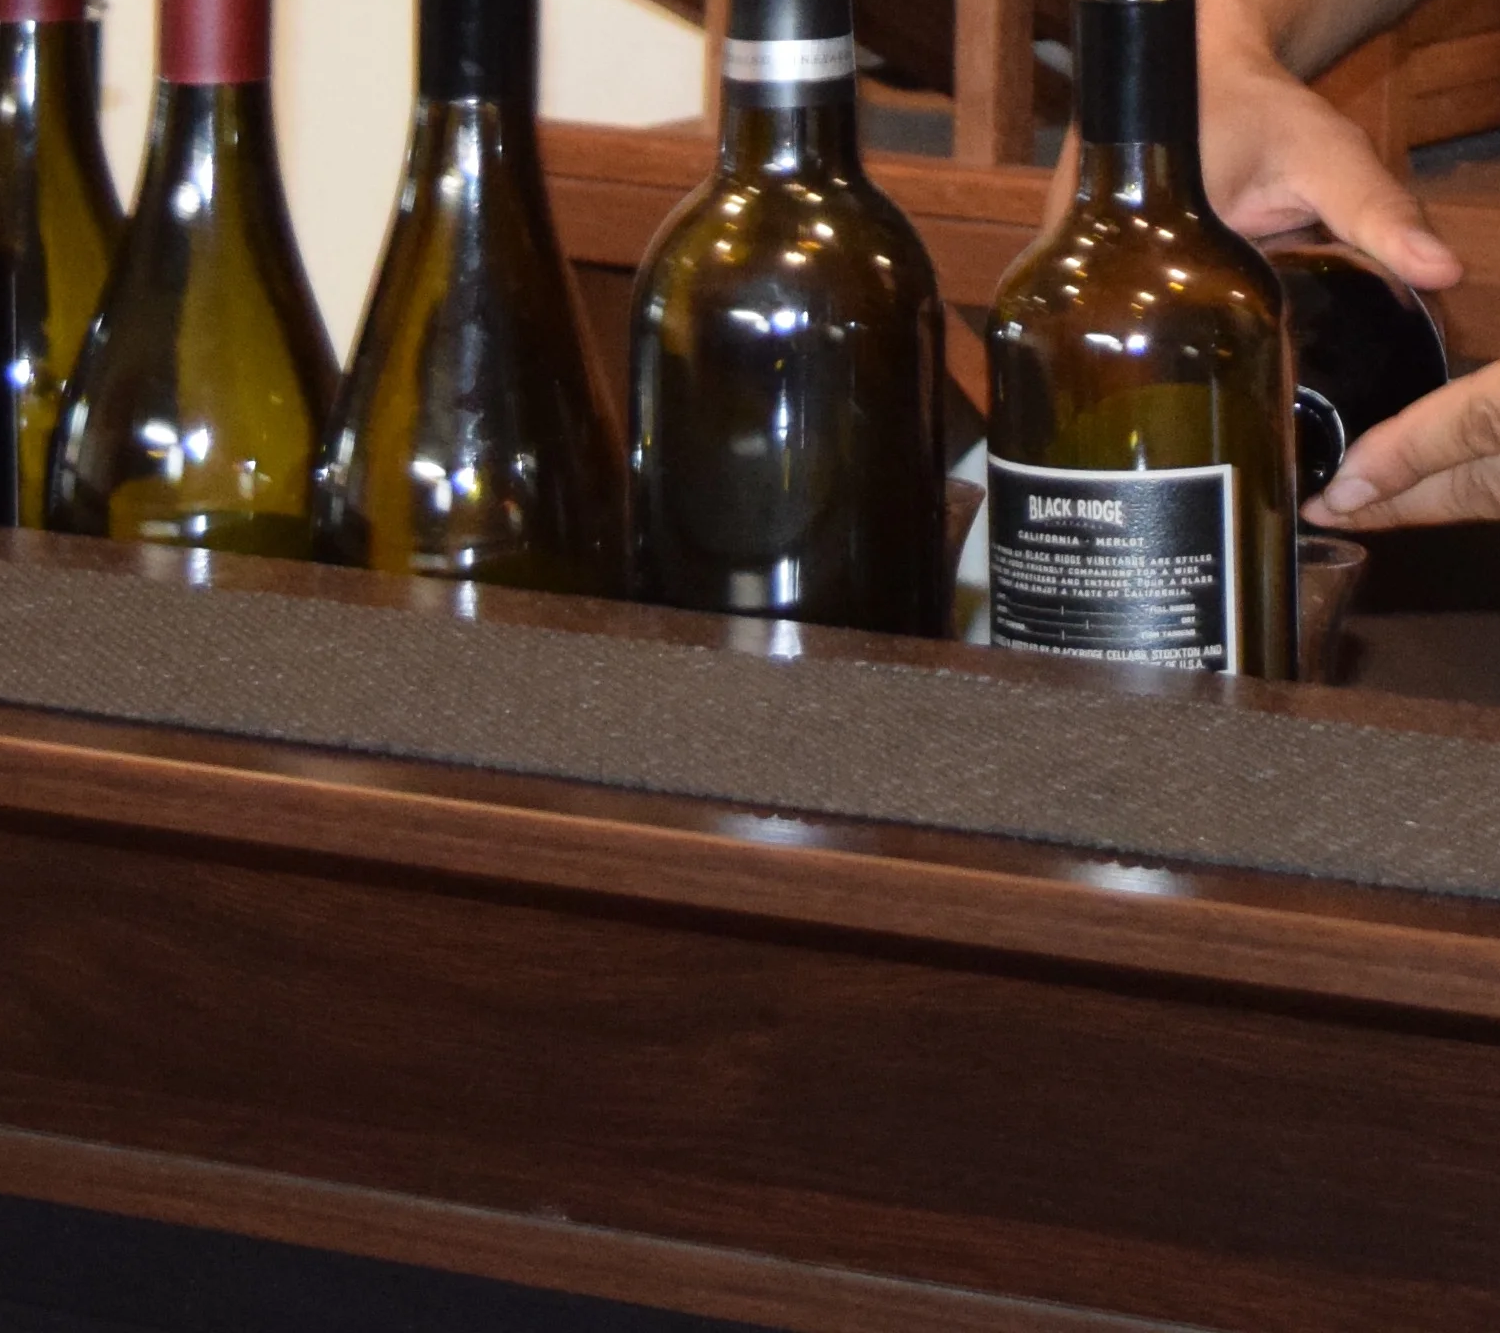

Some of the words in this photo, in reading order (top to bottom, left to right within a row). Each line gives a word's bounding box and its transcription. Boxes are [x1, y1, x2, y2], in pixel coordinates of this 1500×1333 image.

[1029, 494, 1072, 520] BLACK
[1077, 499, 1124, 524] RIDGE
[1017, 529, 1080, 546] CALIFORNIA
[1095, 536, 1145, 546] MERLOT
[1086, 555, 1145, 567] VINEYARDS
[1152, 646, 1201, 660] STOCKTON
[1203, 644, 1223, 656] AND
